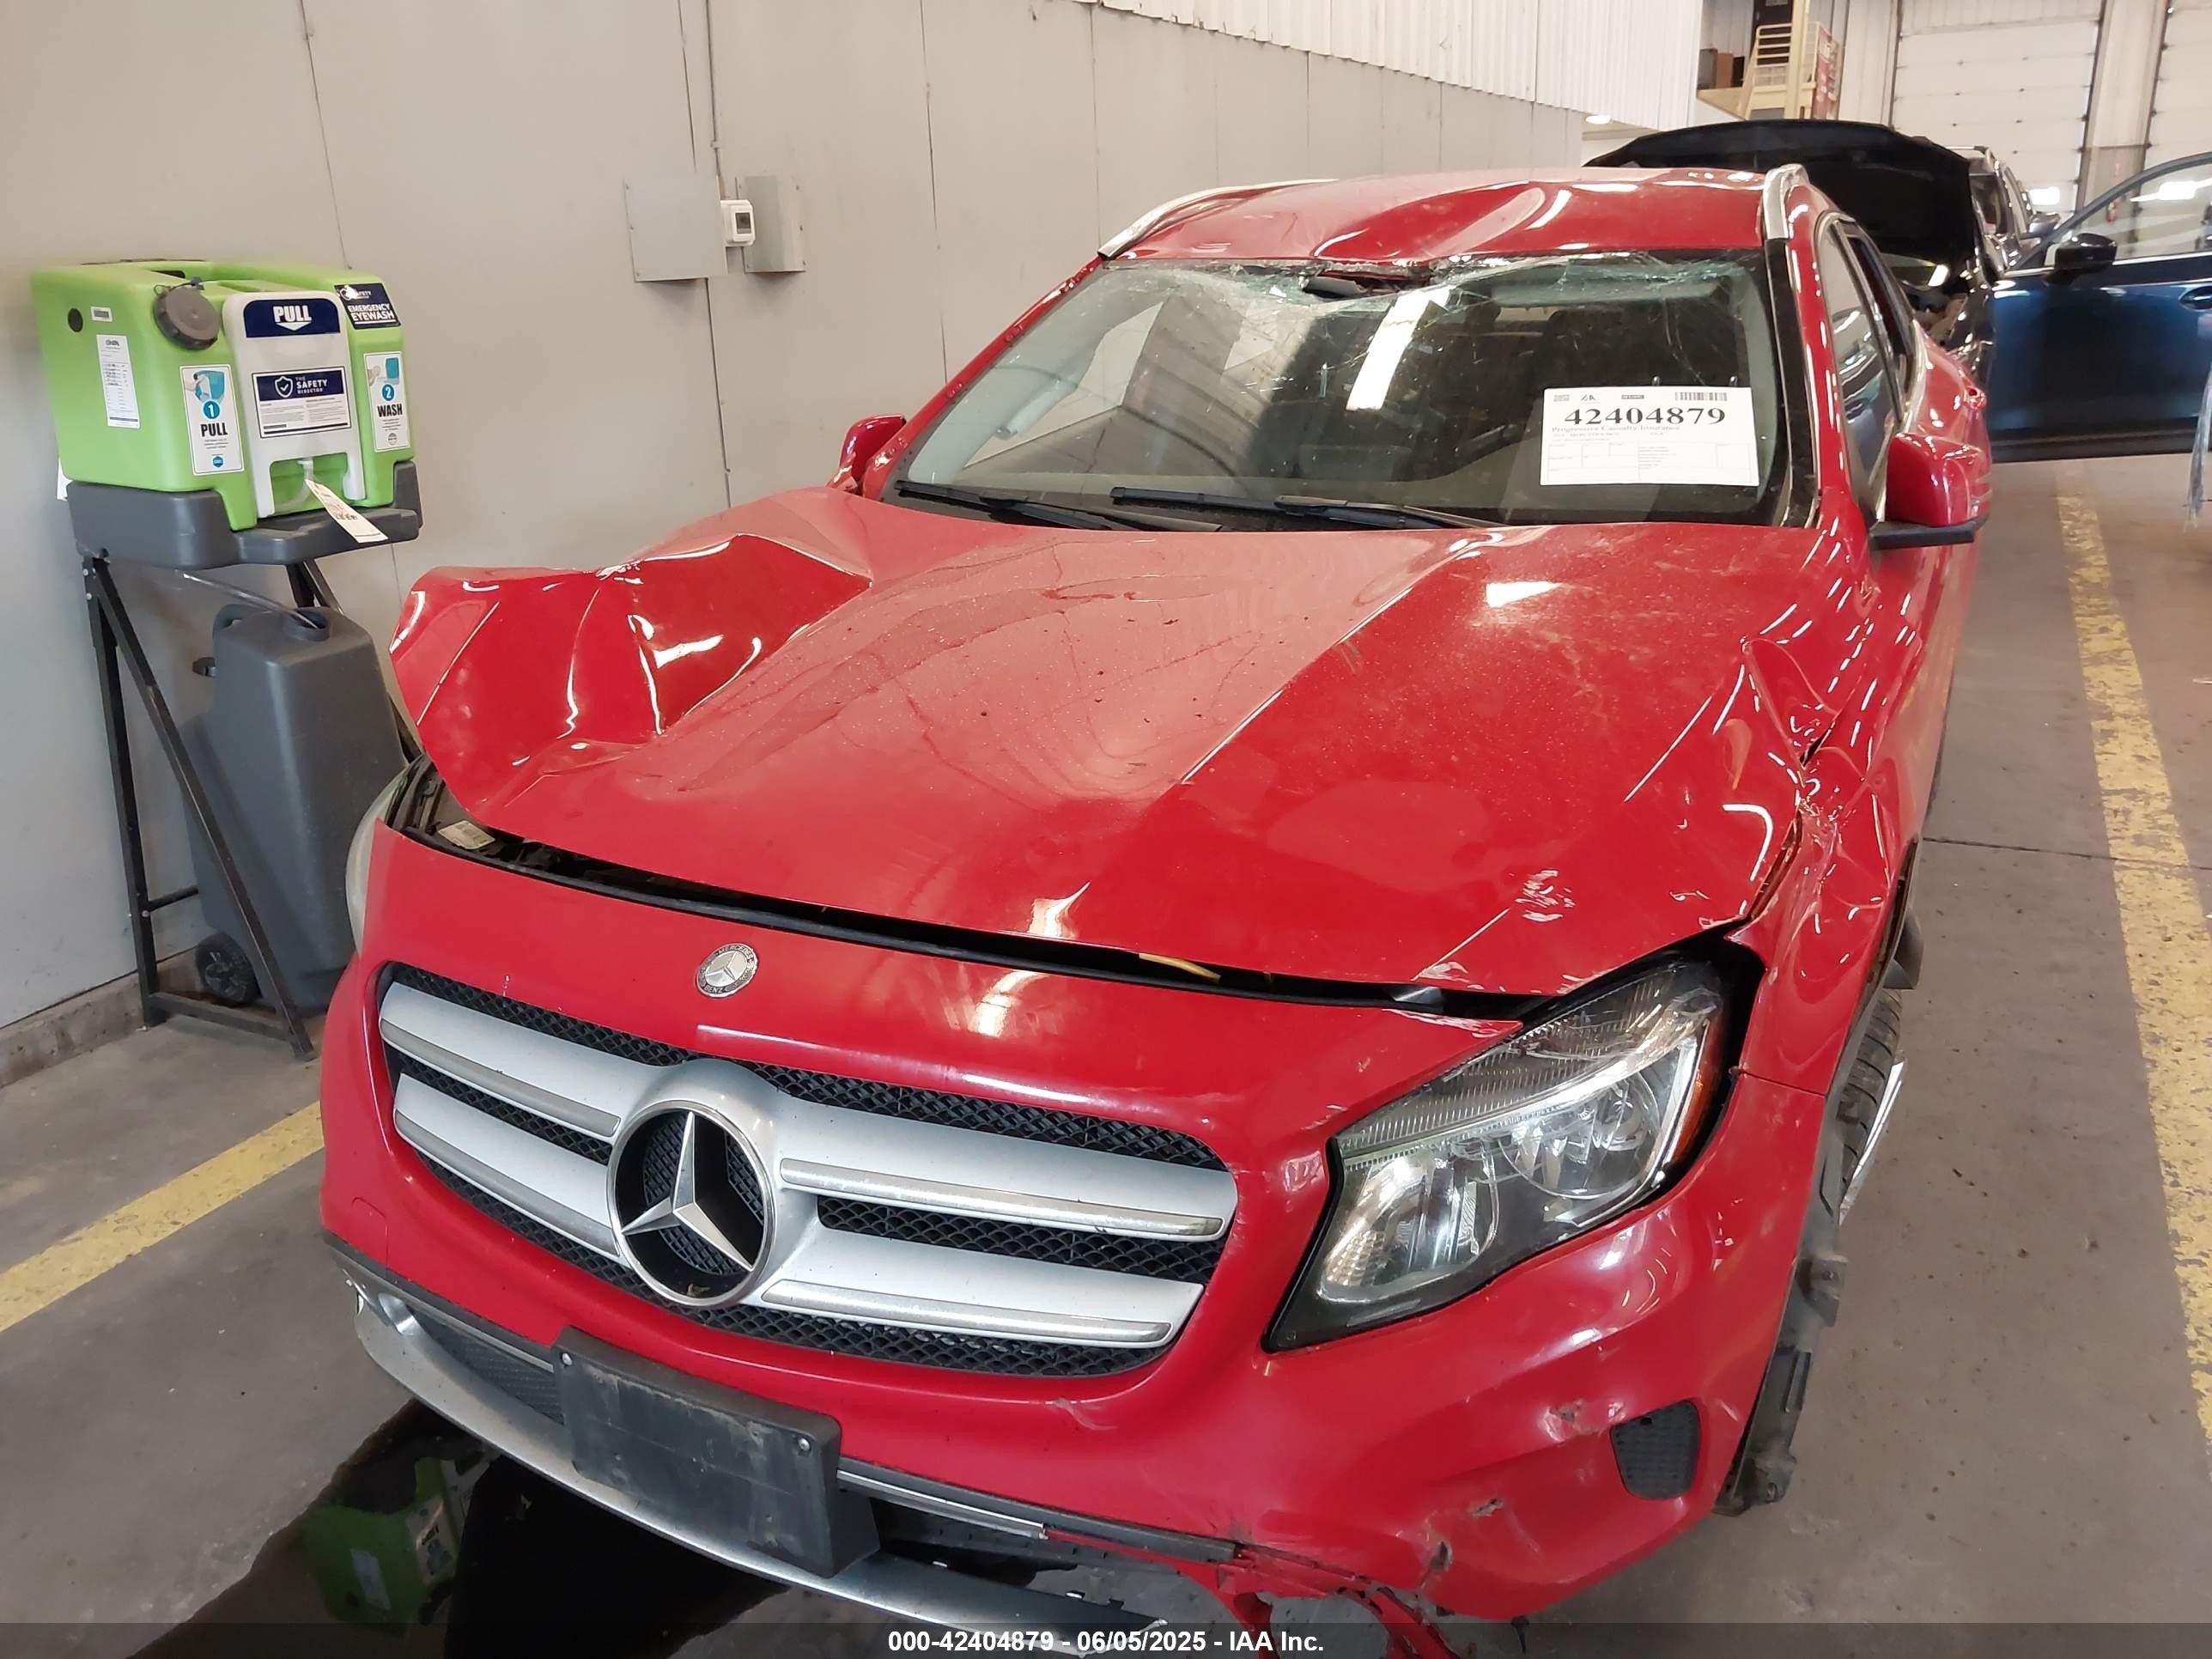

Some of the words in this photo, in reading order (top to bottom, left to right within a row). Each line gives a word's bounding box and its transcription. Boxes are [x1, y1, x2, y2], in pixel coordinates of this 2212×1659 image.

[272, 305, 312, 323] PULL
[347, 303, 391, 313] EMERGENCY
[350, 310, 395, 322] EYEWASH
[296, 379, 328, 389] SAFETY
[385, 386, 392, 399] 2
[208, 404, 215, 418] 1
[377, 403, 404, 418] WASH
[1564, 407, 1726, 425] 42404879
[200, 422, 228, 437] PULL
[703, 985, 724, 994] BENZ
